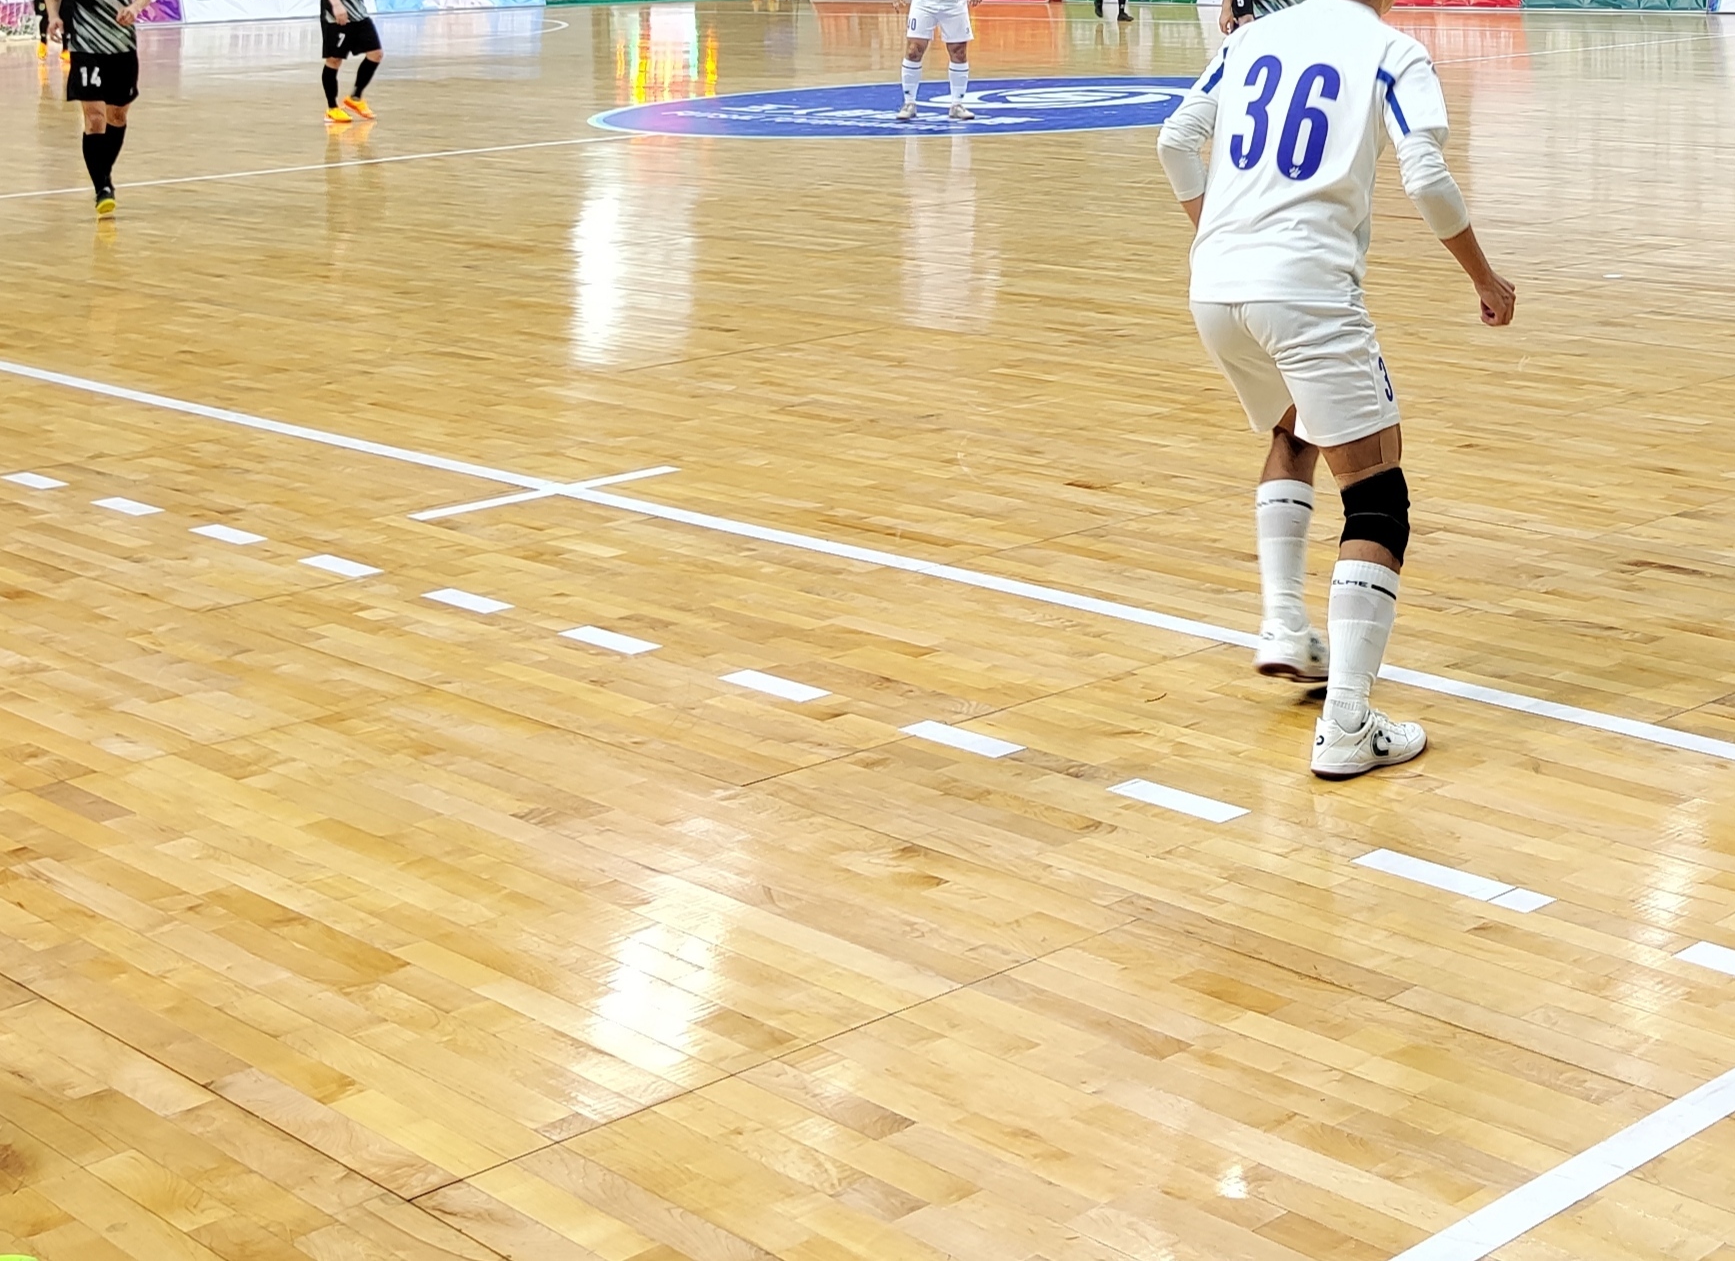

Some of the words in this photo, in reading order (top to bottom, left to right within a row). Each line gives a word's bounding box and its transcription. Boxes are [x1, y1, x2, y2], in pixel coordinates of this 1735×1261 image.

[337, 33, 346, 48] 7
[80, 66, 101, 87] 14
[1230, 55, 1341, 181] 36
